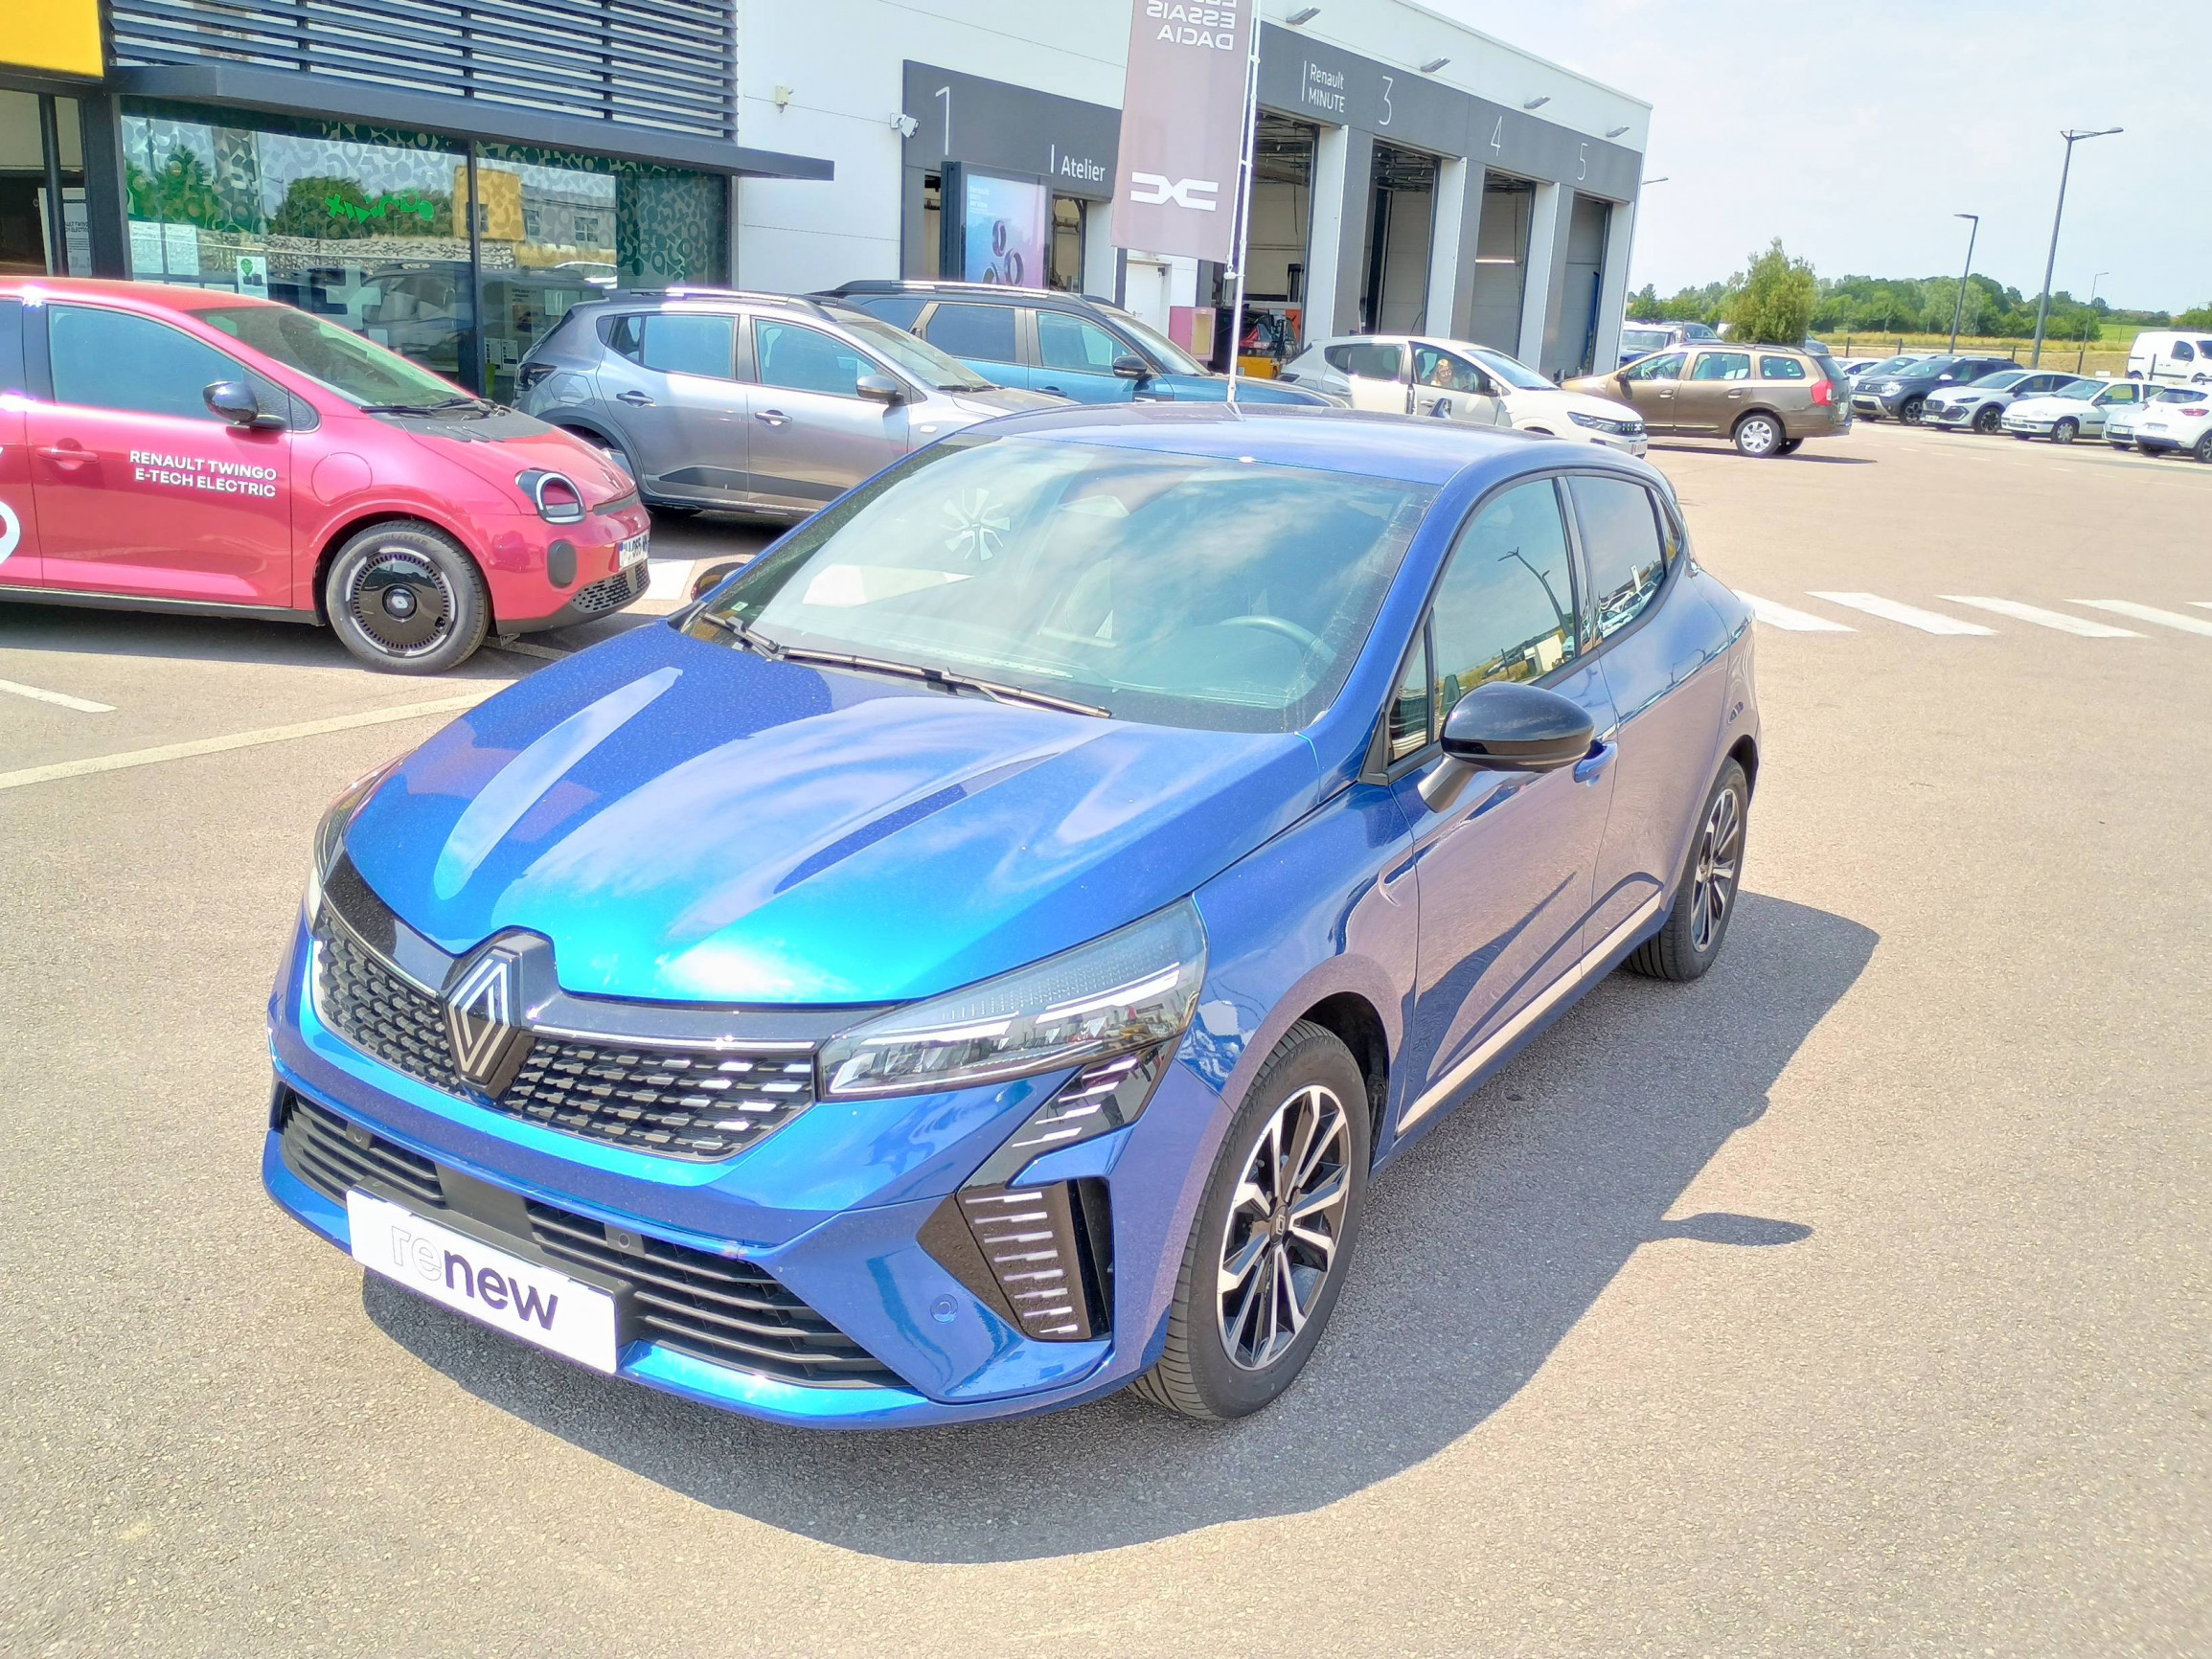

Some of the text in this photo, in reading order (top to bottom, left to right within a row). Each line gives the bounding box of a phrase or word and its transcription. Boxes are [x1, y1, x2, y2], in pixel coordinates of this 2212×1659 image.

[1311, 63, 1344, 90] Renault
[1309, 87, 1345, 113] MINUTE
[1379, 76, 1394, 125] 3
[935, 86, 950, 156] 1
[1491, 116, 1502, 156] 4
[1061, 155, 1106, 182] Atelier
[1577, 143, 1588, 181] 5
[129, 450, 277, 481] RENAULT TWINGO
[135, 467, 276, 497] E-TECH ELECTRIC
[391, 1226, 559, 1331] renew
